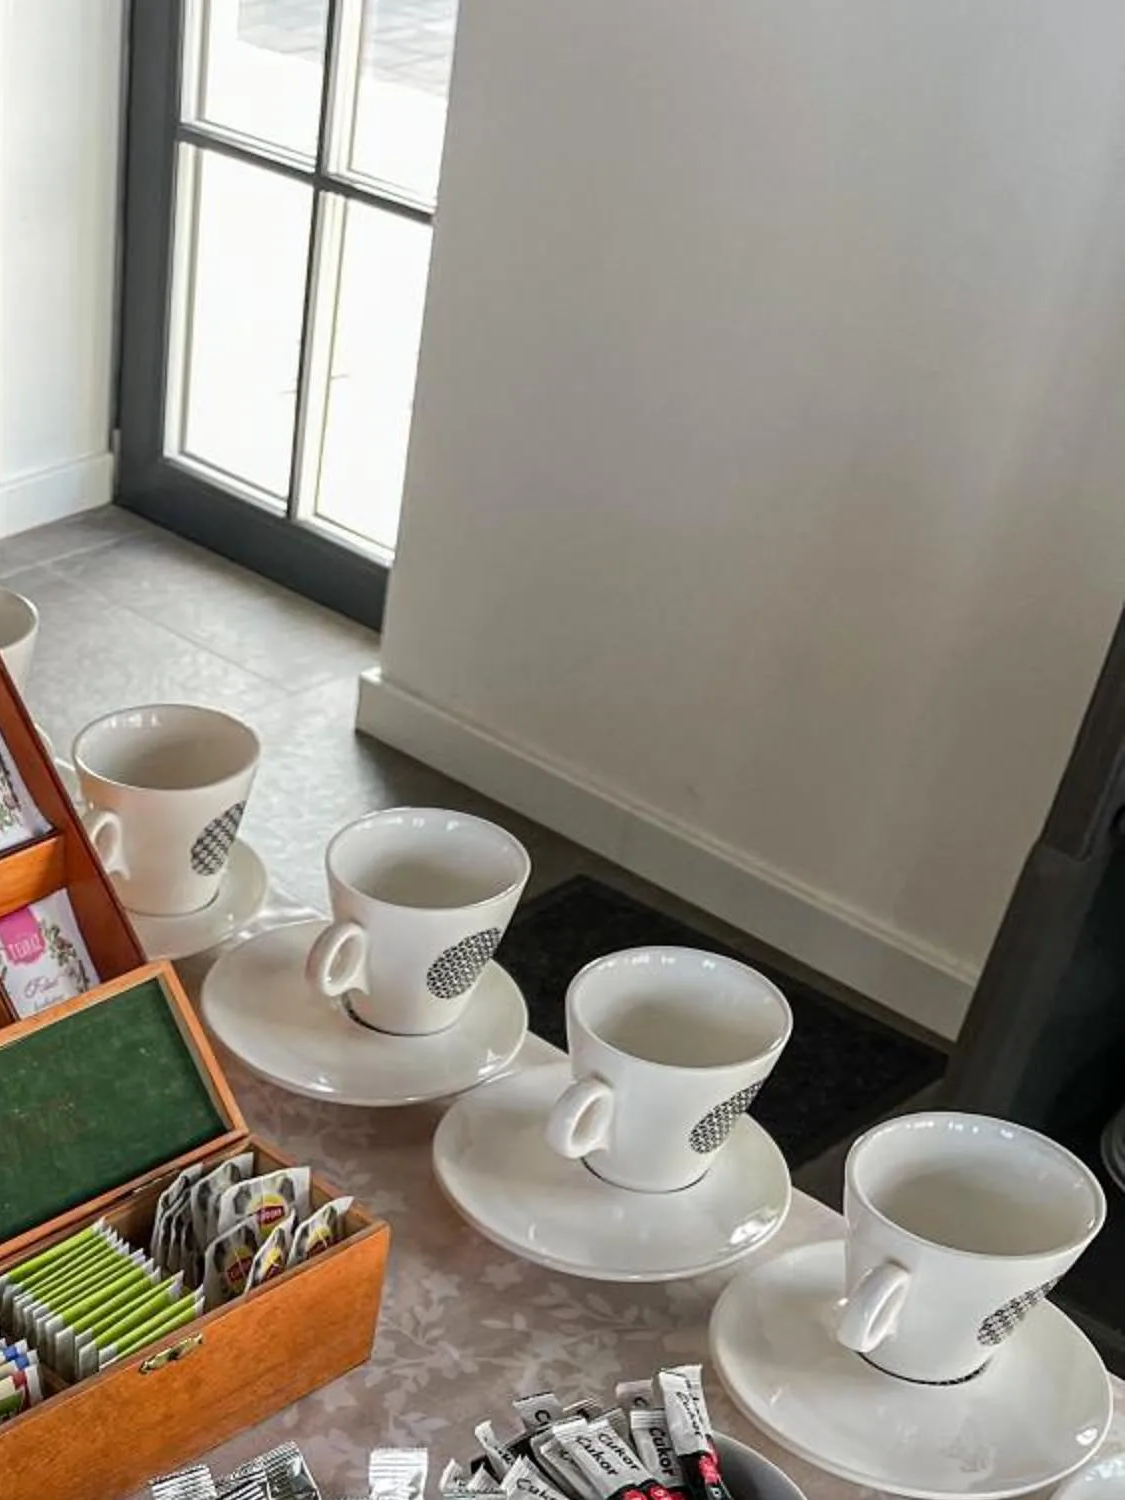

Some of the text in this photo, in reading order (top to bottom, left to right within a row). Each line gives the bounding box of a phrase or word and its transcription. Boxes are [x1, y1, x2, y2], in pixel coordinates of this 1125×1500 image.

[576, 1435, 619, 1476] Cukor
[599, 1432, 641, 1471] Cukor
[649, 1427, 675, 1477] Cukor
